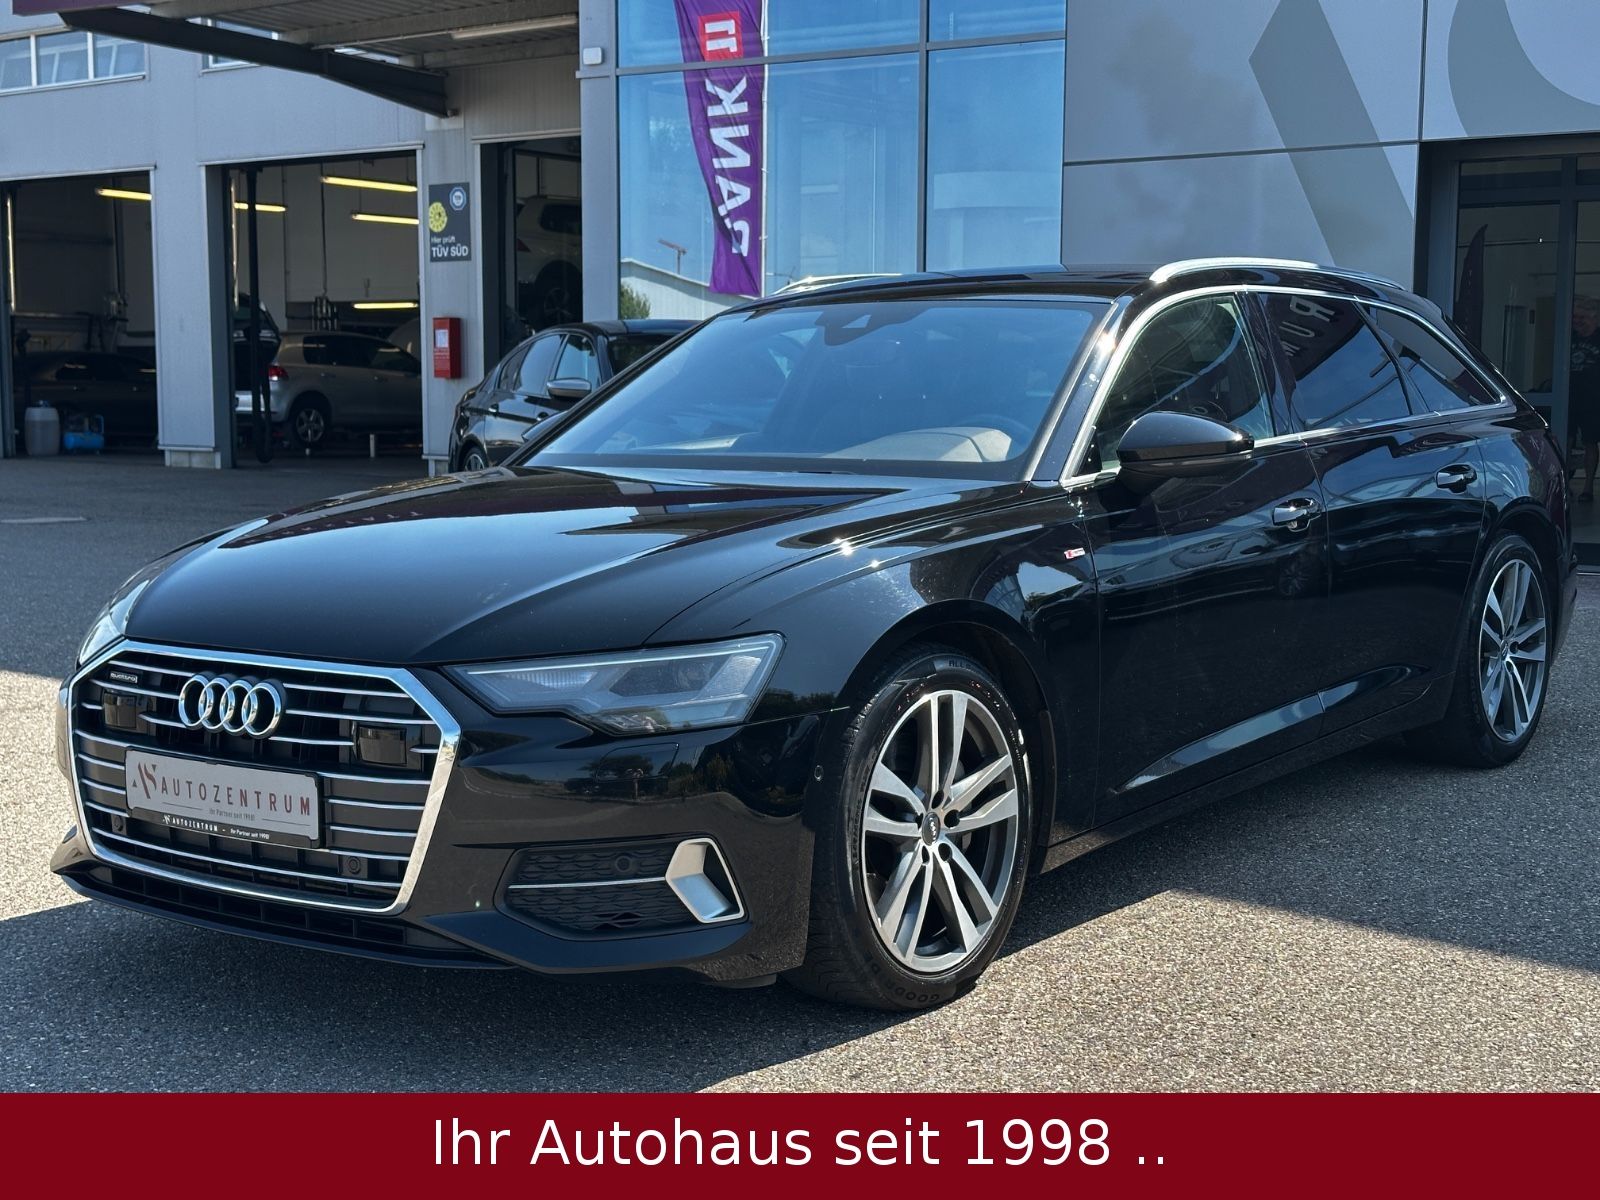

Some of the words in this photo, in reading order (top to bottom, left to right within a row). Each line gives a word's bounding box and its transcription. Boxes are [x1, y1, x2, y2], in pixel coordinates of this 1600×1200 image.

[431, 244, 449, 257] TÜV
[450, 243, 468, 257] SÜD
[161, 776, 310, 816] AUTOZENTRUM
[172, 816, 218, 832] AUTOZENTRUM
